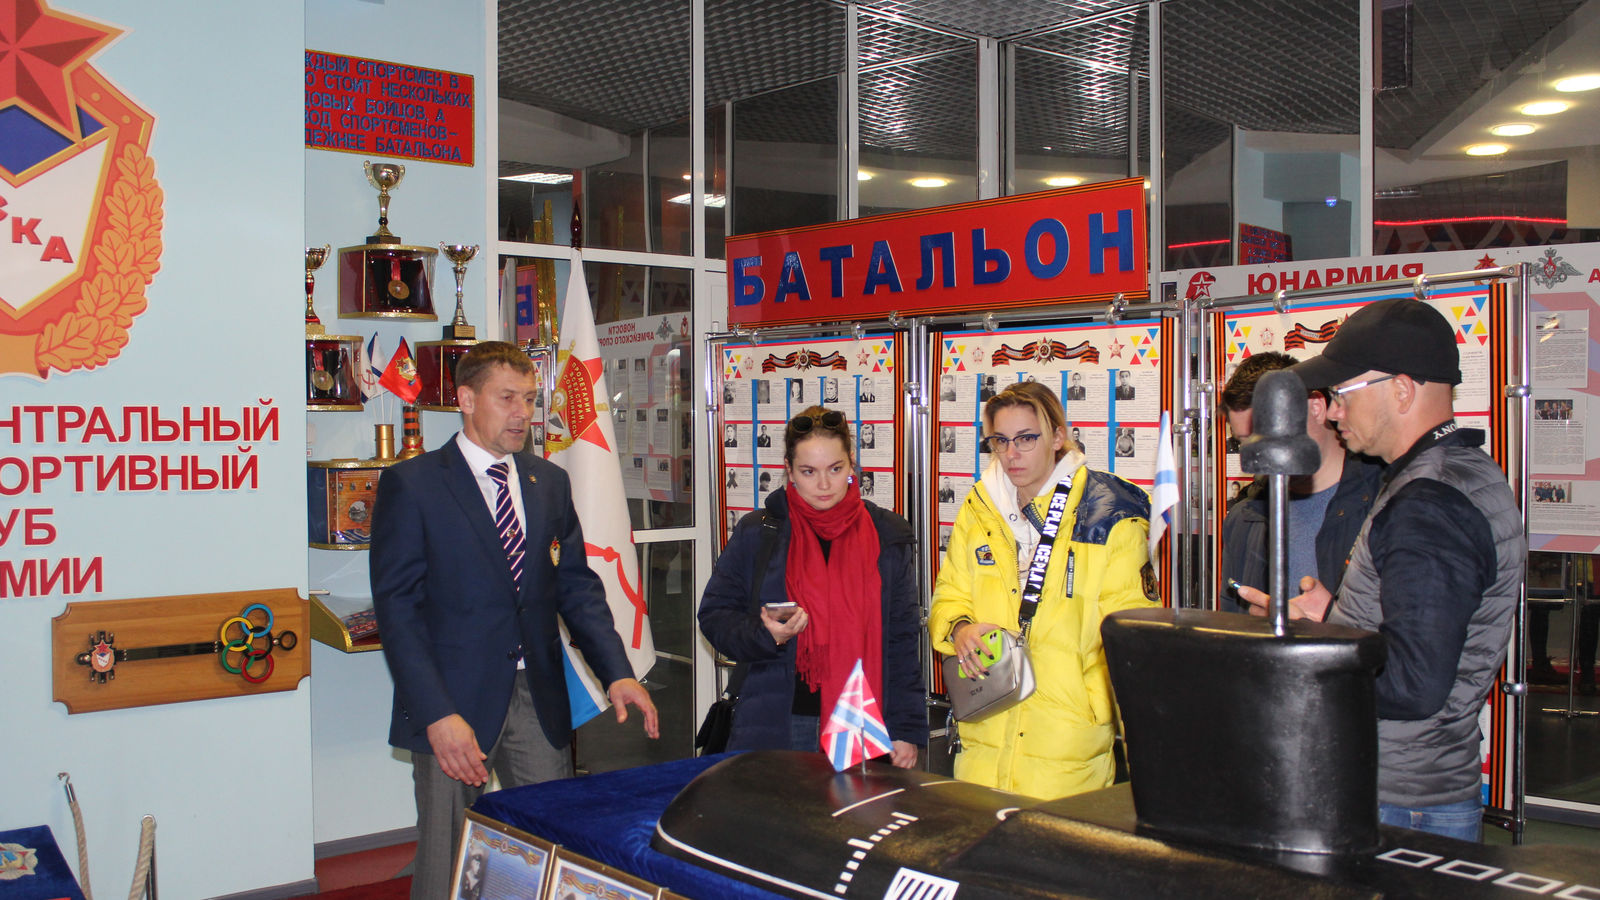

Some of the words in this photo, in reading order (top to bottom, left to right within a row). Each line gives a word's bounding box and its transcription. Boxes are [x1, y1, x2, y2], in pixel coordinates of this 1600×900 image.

[324, 74, 372, 94] СТОИТ
[381, 81, 472, 109] НЕСКОЛЬКИХ
[356, 60, 443, 87] СПОРТСМЕН
[450, 75, 459, 89] В
[366, 98, 429, 122] БОЙЦОВ,
[435, 108, 445, 123] А
[376, 137, 461, 161] БАТАЛЬОНА
[733, 208, 1135, 307] БАТАЛЬОН
[1248, 262, 1424, 295] ЮНАРМИЯ
[572, 362, 591, 413] ПРОЛЕТАРИИ
[0, 398, 279, 443] НТРАЛЬНЫЙ
[0, 445, 258, 496] ОРТИВНЫЙ
[0, 508, 56, 547] УБ
[0, 556, 103, 598] МИИ
